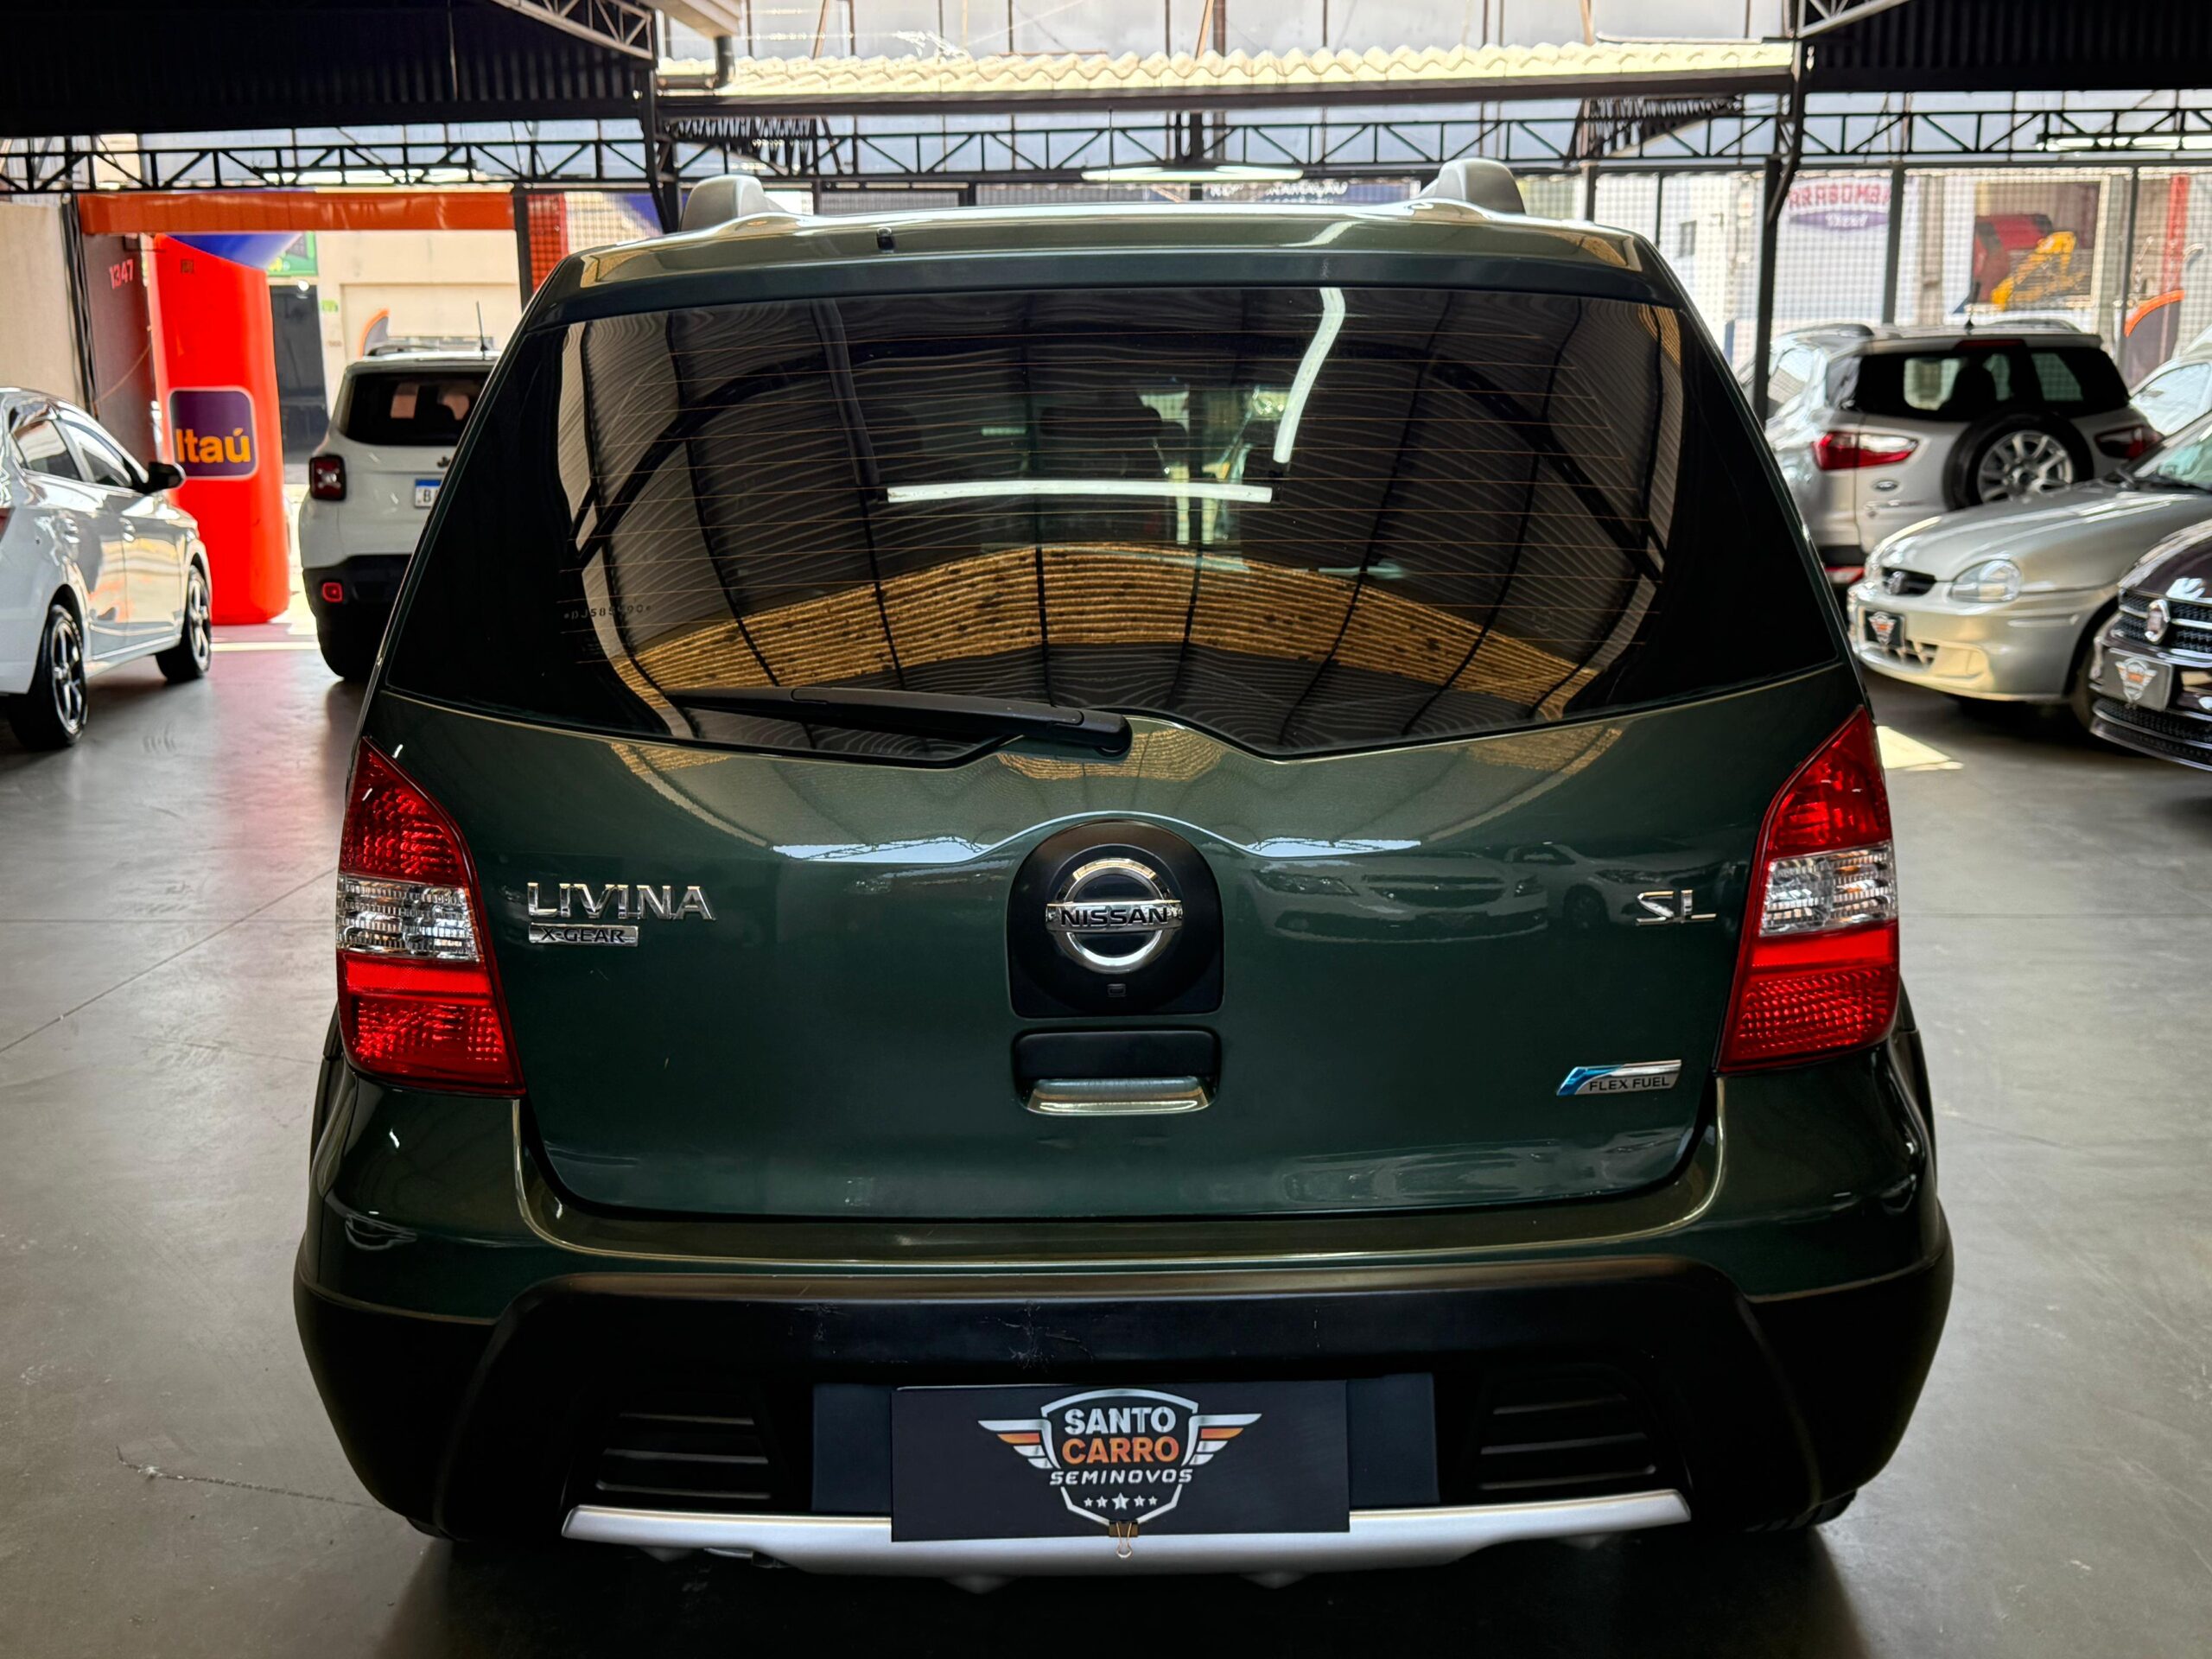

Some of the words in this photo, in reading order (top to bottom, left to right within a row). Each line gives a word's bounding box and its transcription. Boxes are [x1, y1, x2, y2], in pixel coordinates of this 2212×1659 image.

[109, 258, 134, 289] 1347
[175, 428, 251, 464] Itaú
[527, 882, 716, 920] LIVINA
[1636, 889, 1717, 926] SL
[1061, 907, 1168, 927] NISSAN
[541, 927, 626, 944] X-GEAR
[1588, 1078, 1630, 1092] FLEX
[1632, 1076, 1670, 1089] FUEL
[1064, 1406, 1177, 1435] SANTO
[1061, 1435, 1179, 1465] CARRO
[1049, 1468, 1193, 1486] SEMINOVOS
